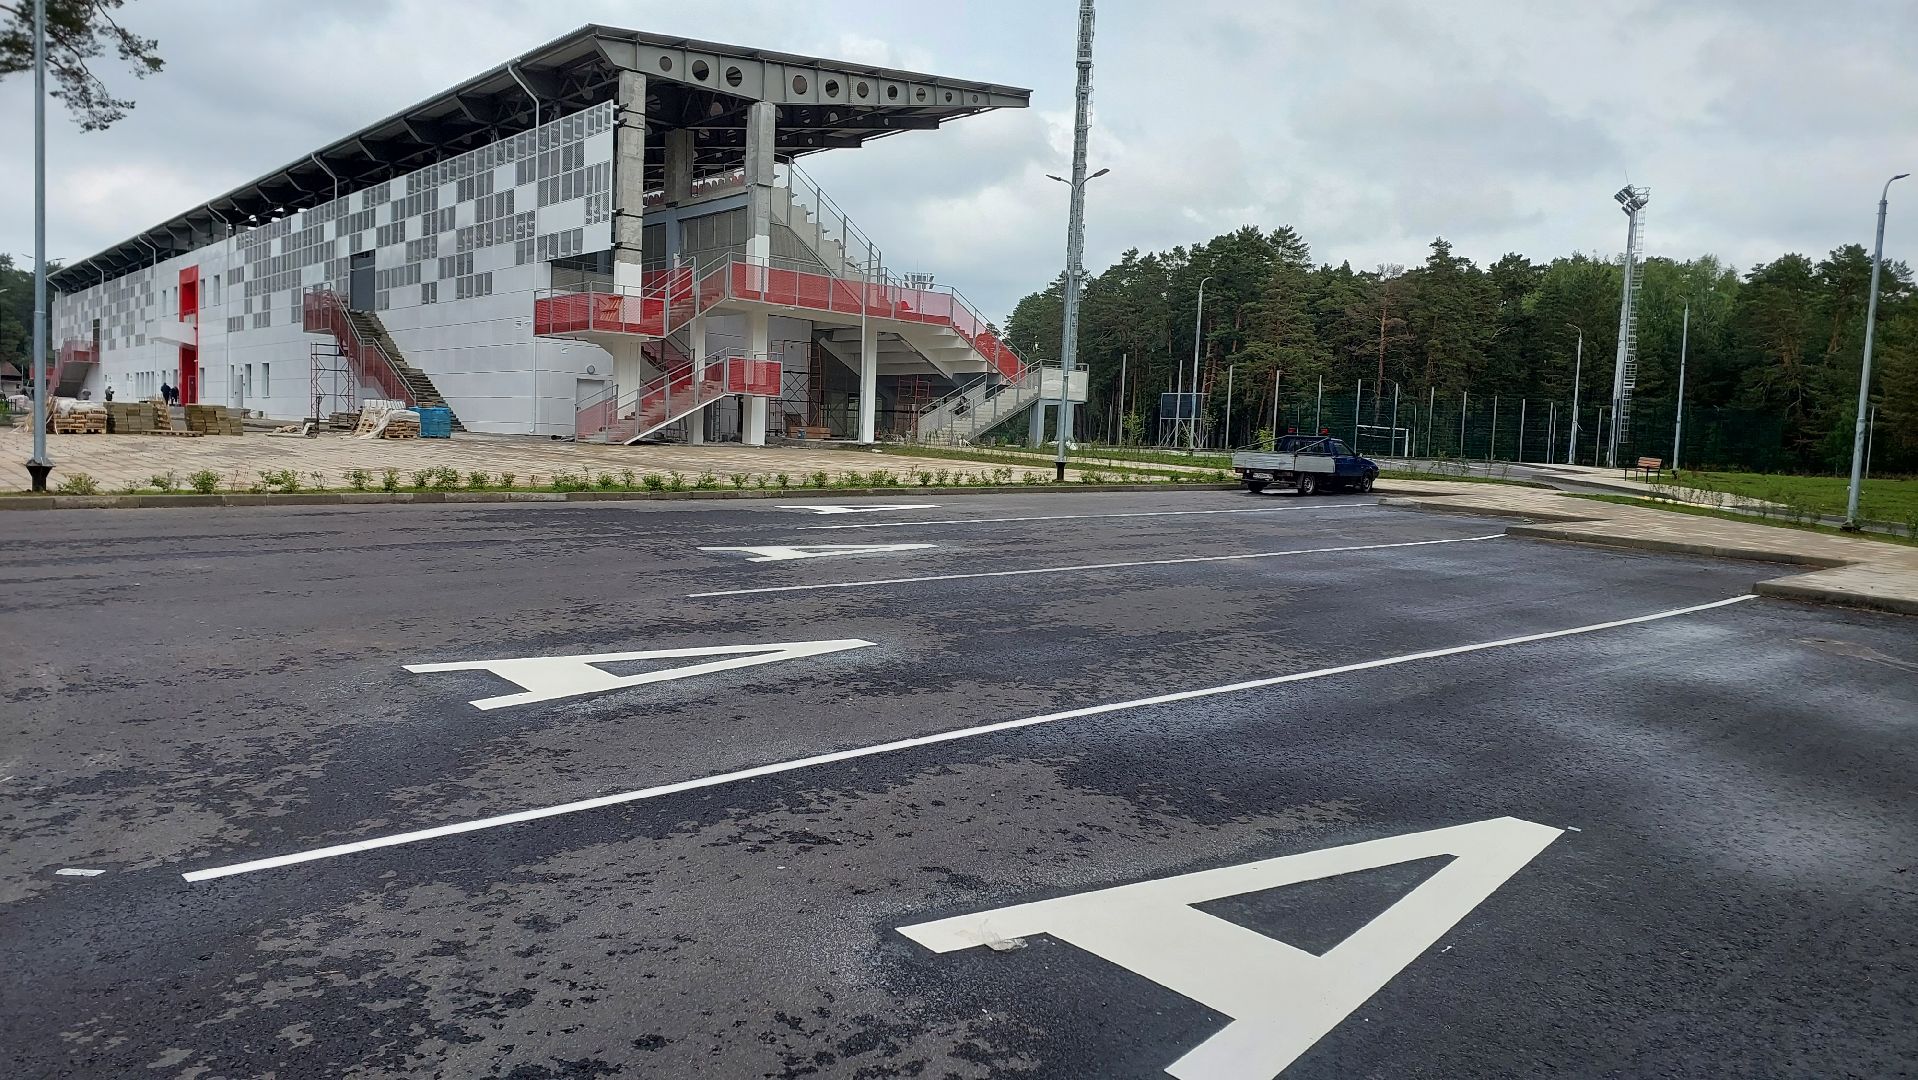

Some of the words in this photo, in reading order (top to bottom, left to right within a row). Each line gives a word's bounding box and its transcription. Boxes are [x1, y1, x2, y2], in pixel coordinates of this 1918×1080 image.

[696, 544, 939, 562] A
[401, 639, 878, 711] A
[895, 816, 1566, 1080] A
